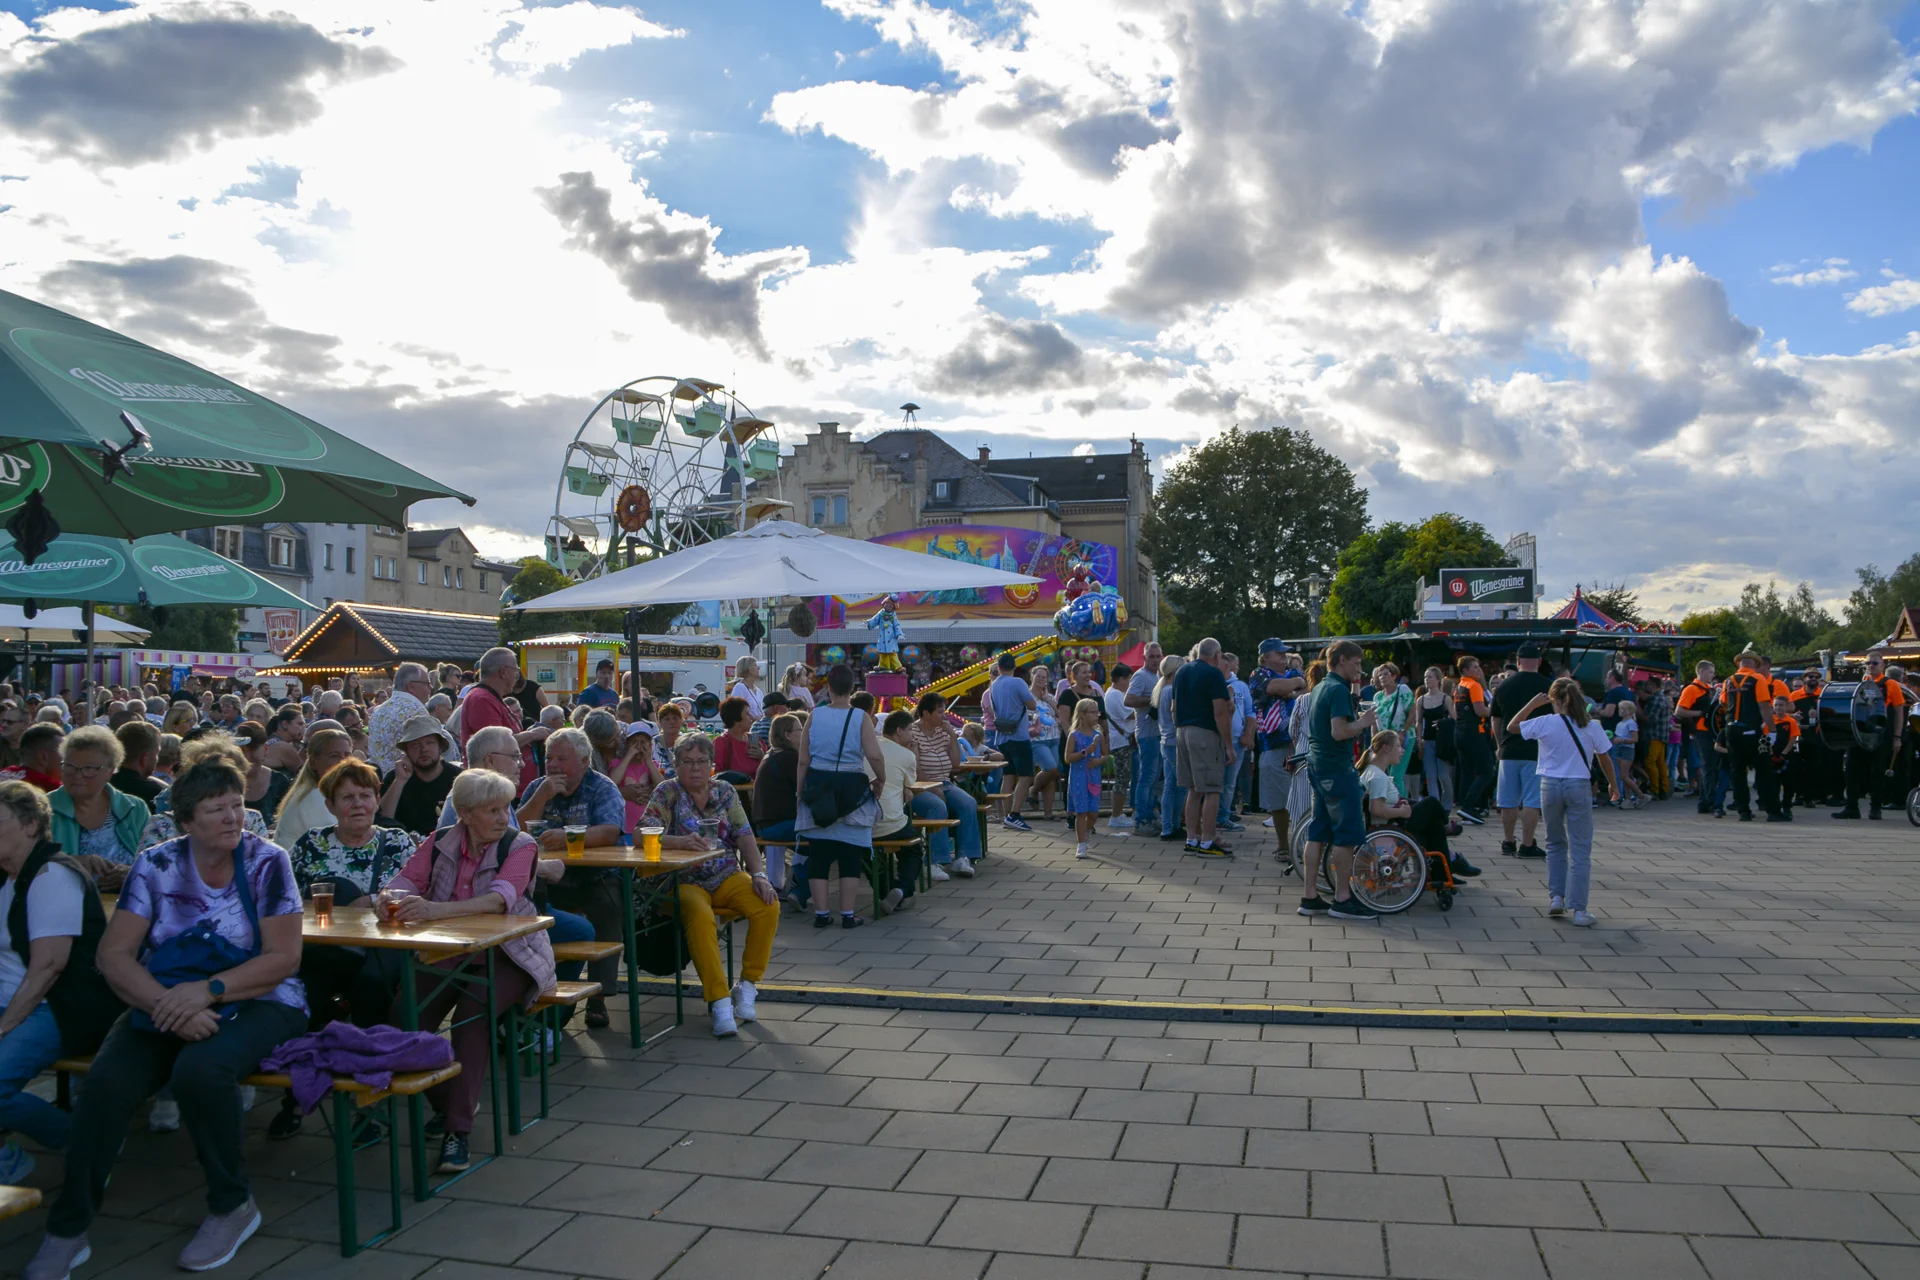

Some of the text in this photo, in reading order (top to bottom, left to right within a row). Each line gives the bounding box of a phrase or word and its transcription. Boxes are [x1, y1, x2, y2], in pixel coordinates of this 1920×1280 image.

[69, 367, 248, 403] Wernesgrüner
[152, 565, 228, 580] Wernesgrüner
[1470, 575, 1525, 598] Wernesgrüner
[622, 644, 719, 657] WFFELMEISTEREI
